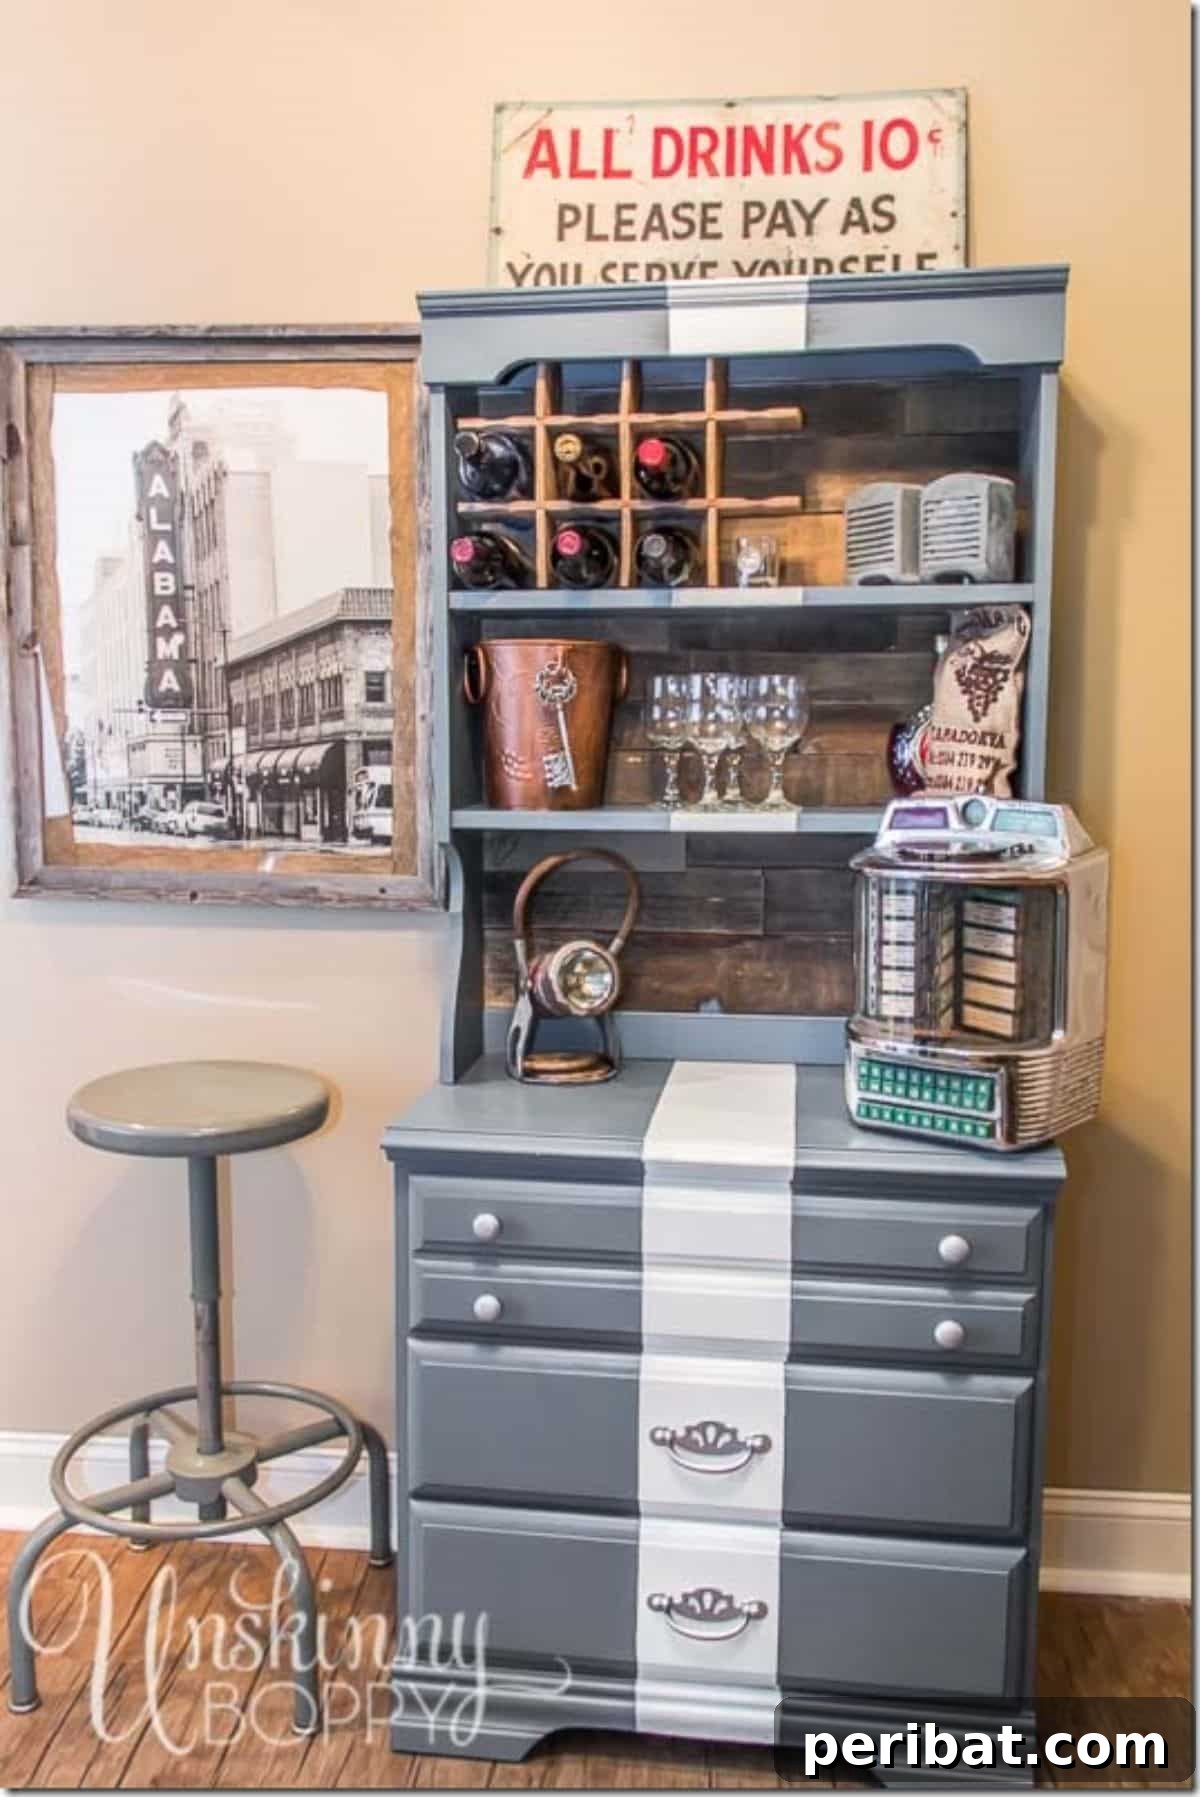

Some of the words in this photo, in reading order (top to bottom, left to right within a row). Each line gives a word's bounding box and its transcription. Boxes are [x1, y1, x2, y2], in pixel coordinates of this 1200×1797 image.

[523, 128, 632, 178] ALL
[651, 121, 845, 178] DRINKS
[556, 201, 724, 241] PLEASE
[741, 197, 830, 238] PAY
[840, 194, 898, 235] AS
[149, 473, 185, 692] ALABAMA
